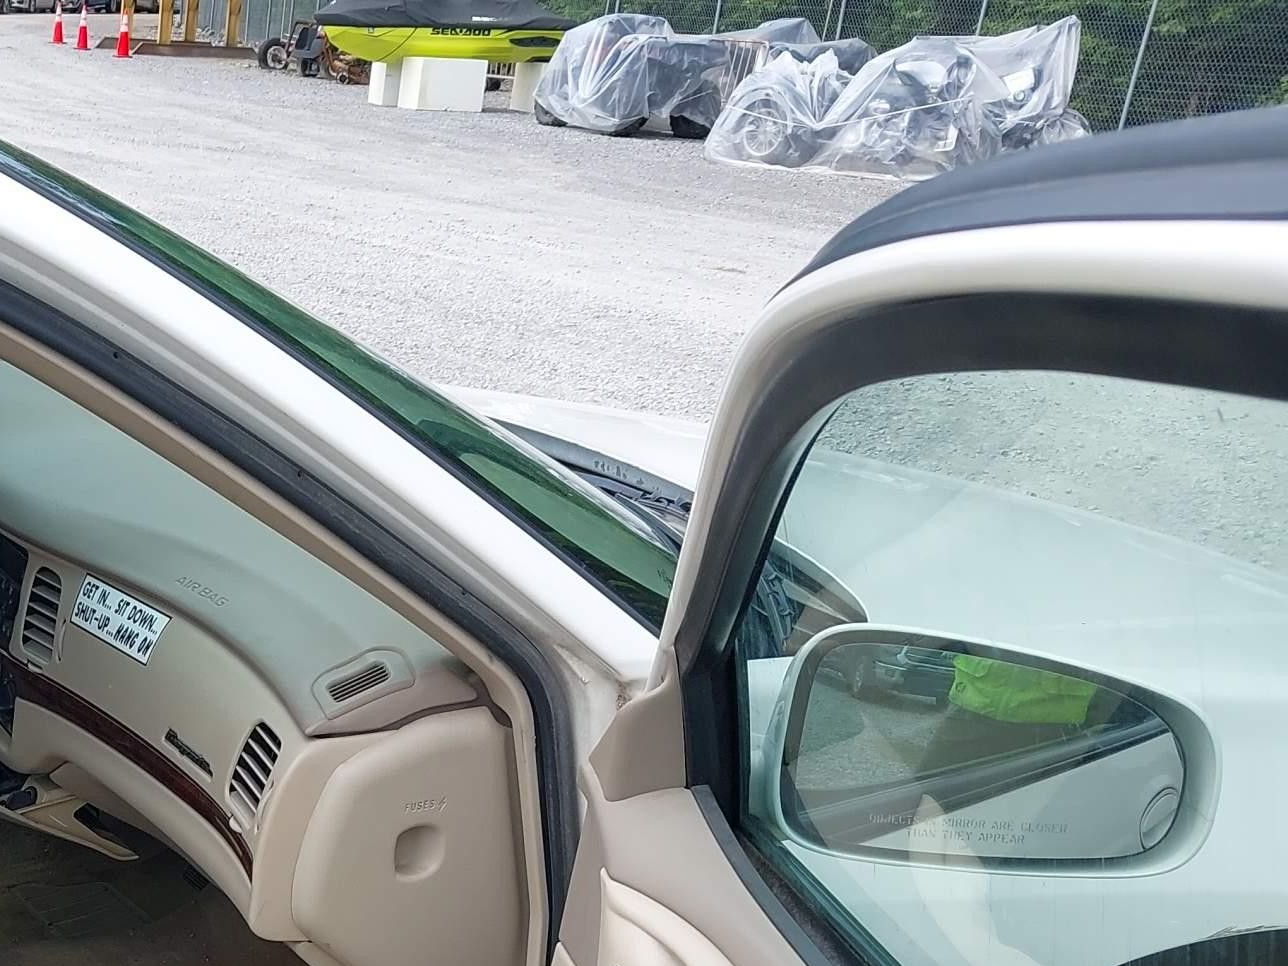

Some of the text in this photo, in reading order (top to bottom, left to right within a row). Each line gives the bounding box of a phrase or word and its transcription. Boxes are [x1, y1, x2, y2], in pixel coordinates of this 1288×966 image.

[82, 581, 100, 601] GET
[114, 598, 131, 618] SIT
[137, 636, 154, 657] ON
[404, 799, 435, 815] FUSES
